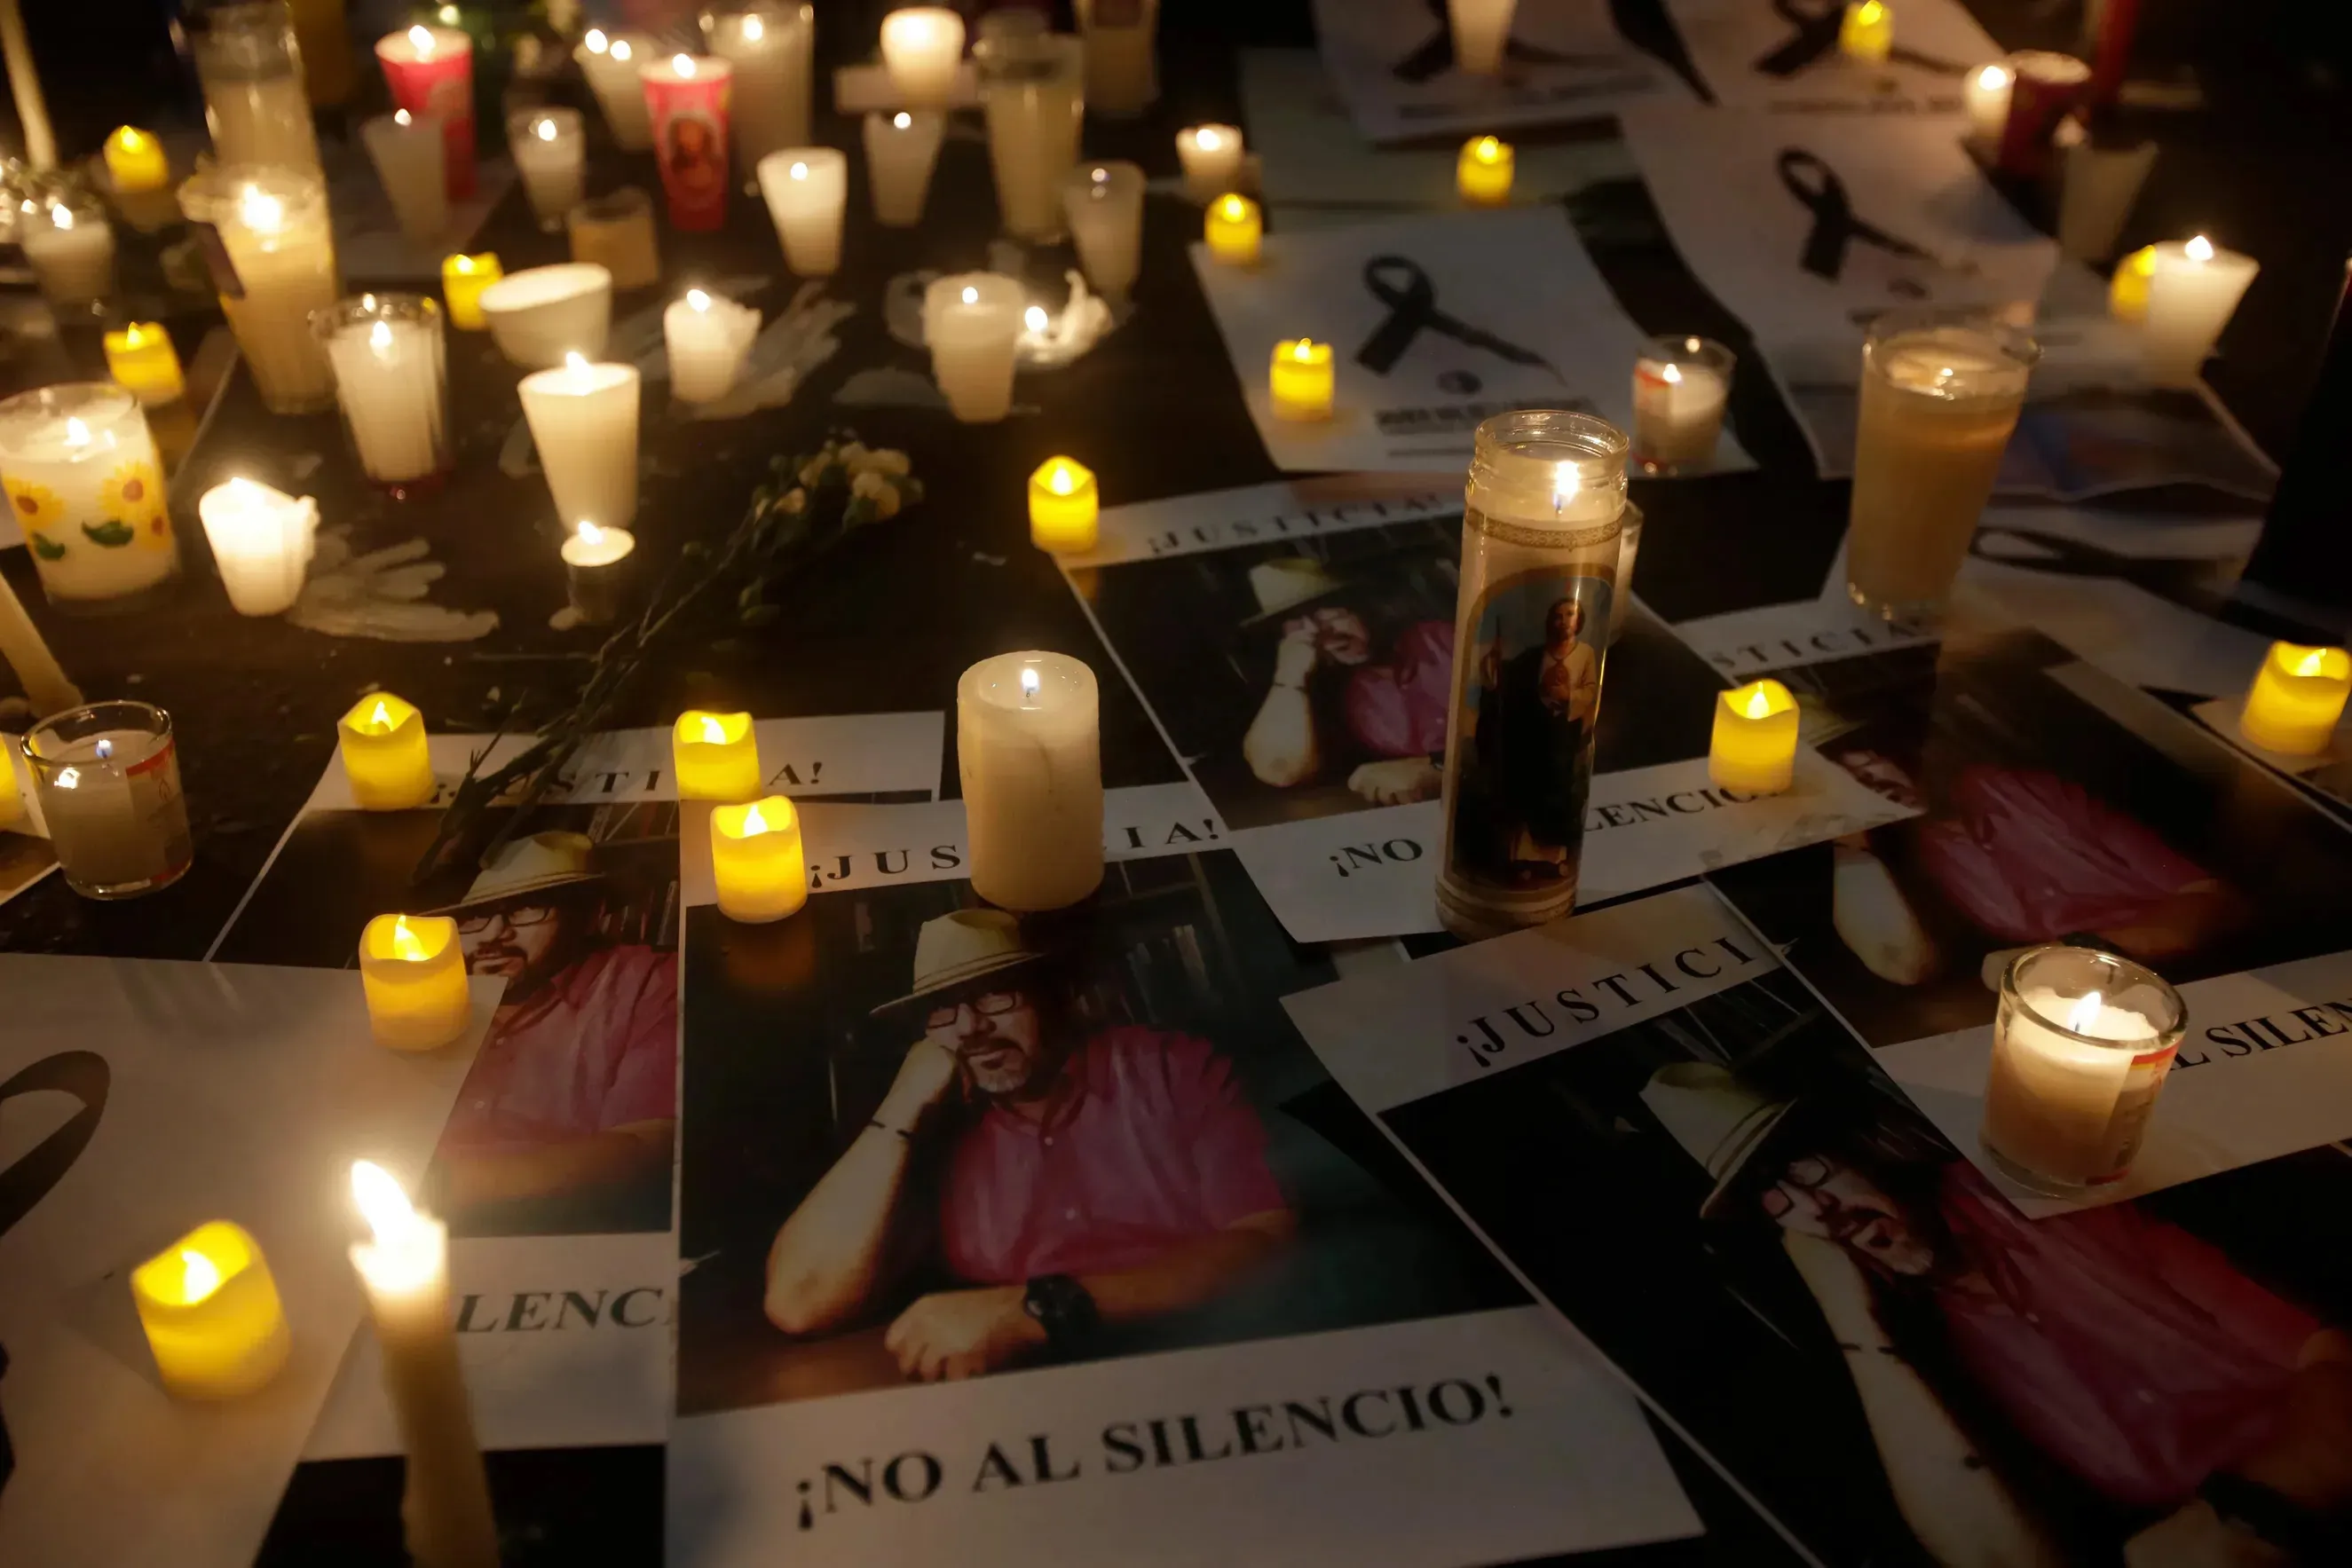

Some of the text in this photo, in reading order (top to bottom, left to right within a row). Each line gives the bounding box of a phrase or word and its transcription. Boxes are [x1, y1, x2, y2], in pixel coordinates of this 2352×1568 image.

[809, 818, 1220, 889] ¡JUSIA!
[1329, 837, 1424, 878] ¡NO
[454, 1287, 679, 1334] LENC
[794, 1374, 1514, 1530] ¡NO AL SILENCIO!
